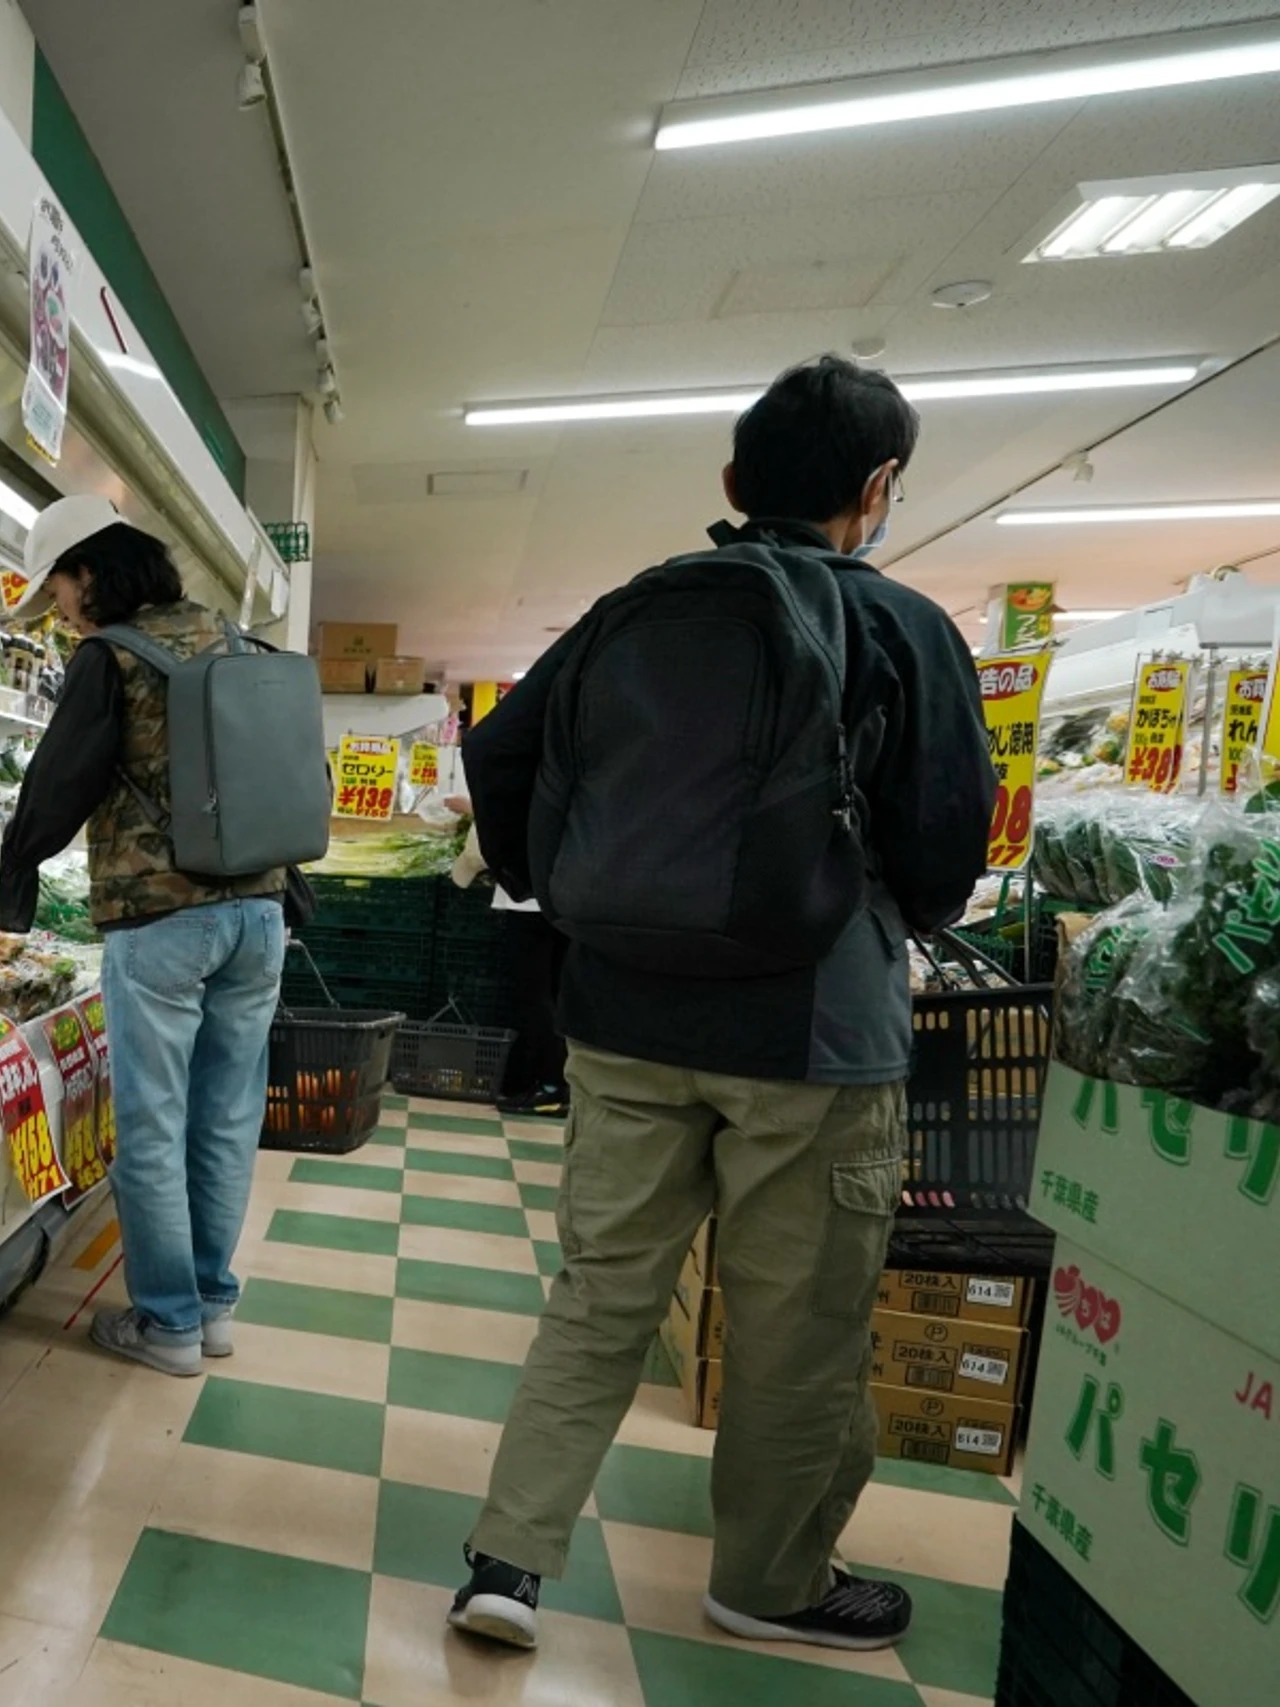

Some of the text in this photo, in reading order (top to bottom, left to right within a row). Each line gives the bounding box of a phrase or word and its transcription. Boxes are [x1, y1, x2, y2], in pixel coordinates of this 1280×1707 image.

[977, 664, 1033, 695] 告の品
[342, 763, 394, 777] セロリー
[1040, 1170, 1100, 1225] 千葉県産
[968, 1285, 992, 1298] 614
[962, 1360, 985, 1373] 614
[1235, 1371, 1273, 1420] JA
[1065, 1374, 1280, 1625] パセリ
[1031, 1482, 1093, 1563] 千葉県産
